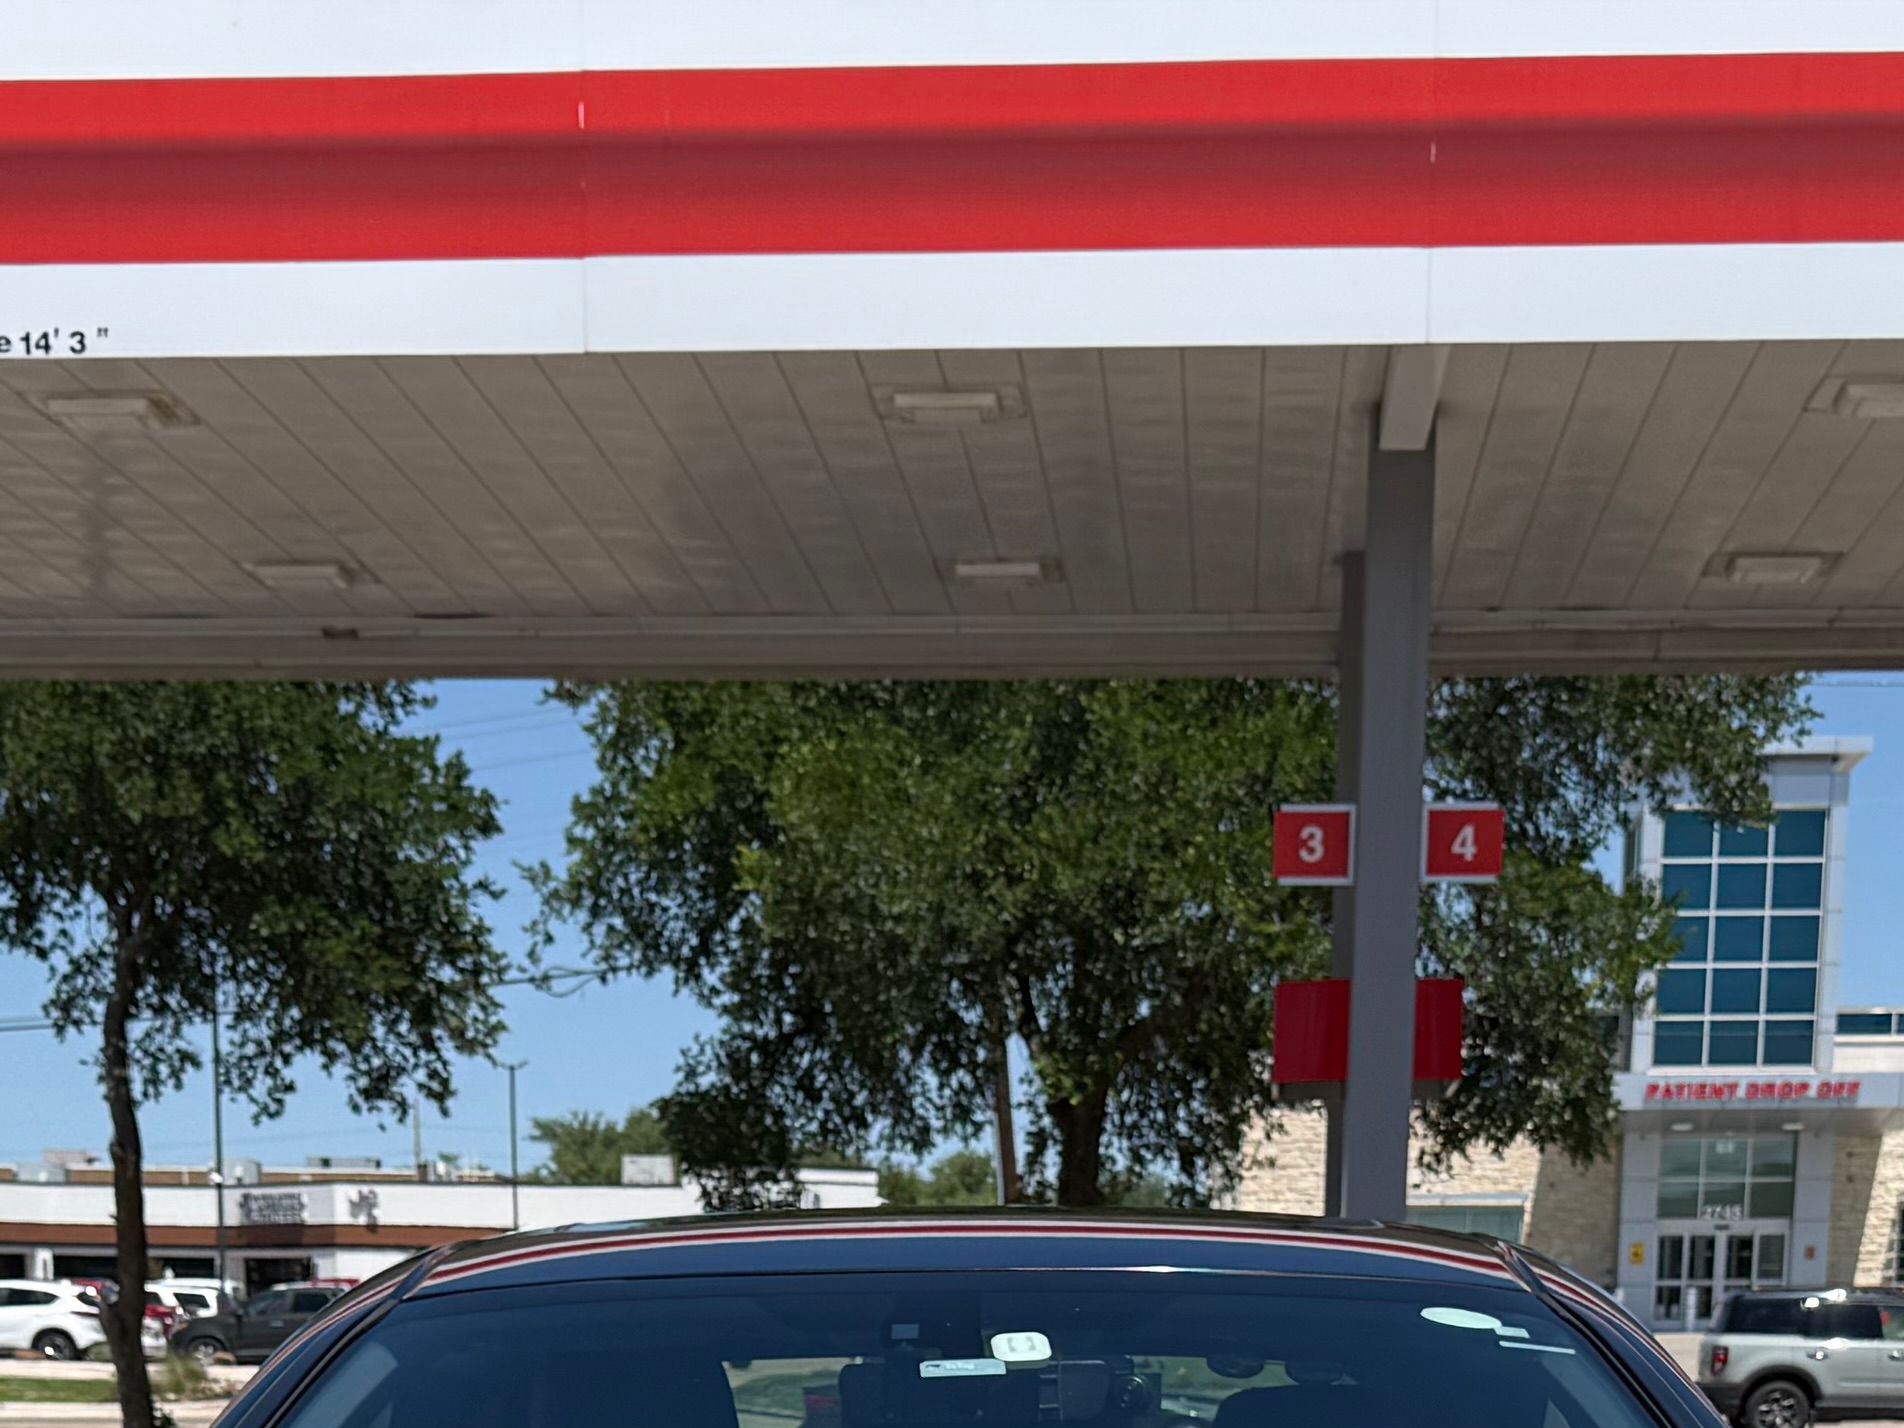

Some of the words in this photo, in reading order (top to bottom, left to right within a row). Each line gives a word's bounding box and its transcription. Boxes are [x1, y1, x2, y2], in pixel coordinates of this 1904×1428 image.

[20, 327, 60, 355] 14'
[1298, 825, 1324, 863] 3
[1451, 823, 1477, 862] 4
[1646, 1081, 1739, 1101] PATIENT
[1745, 1081, 1811, 1100] DROP
[1817, 1079, 1862, 1098] OFF
